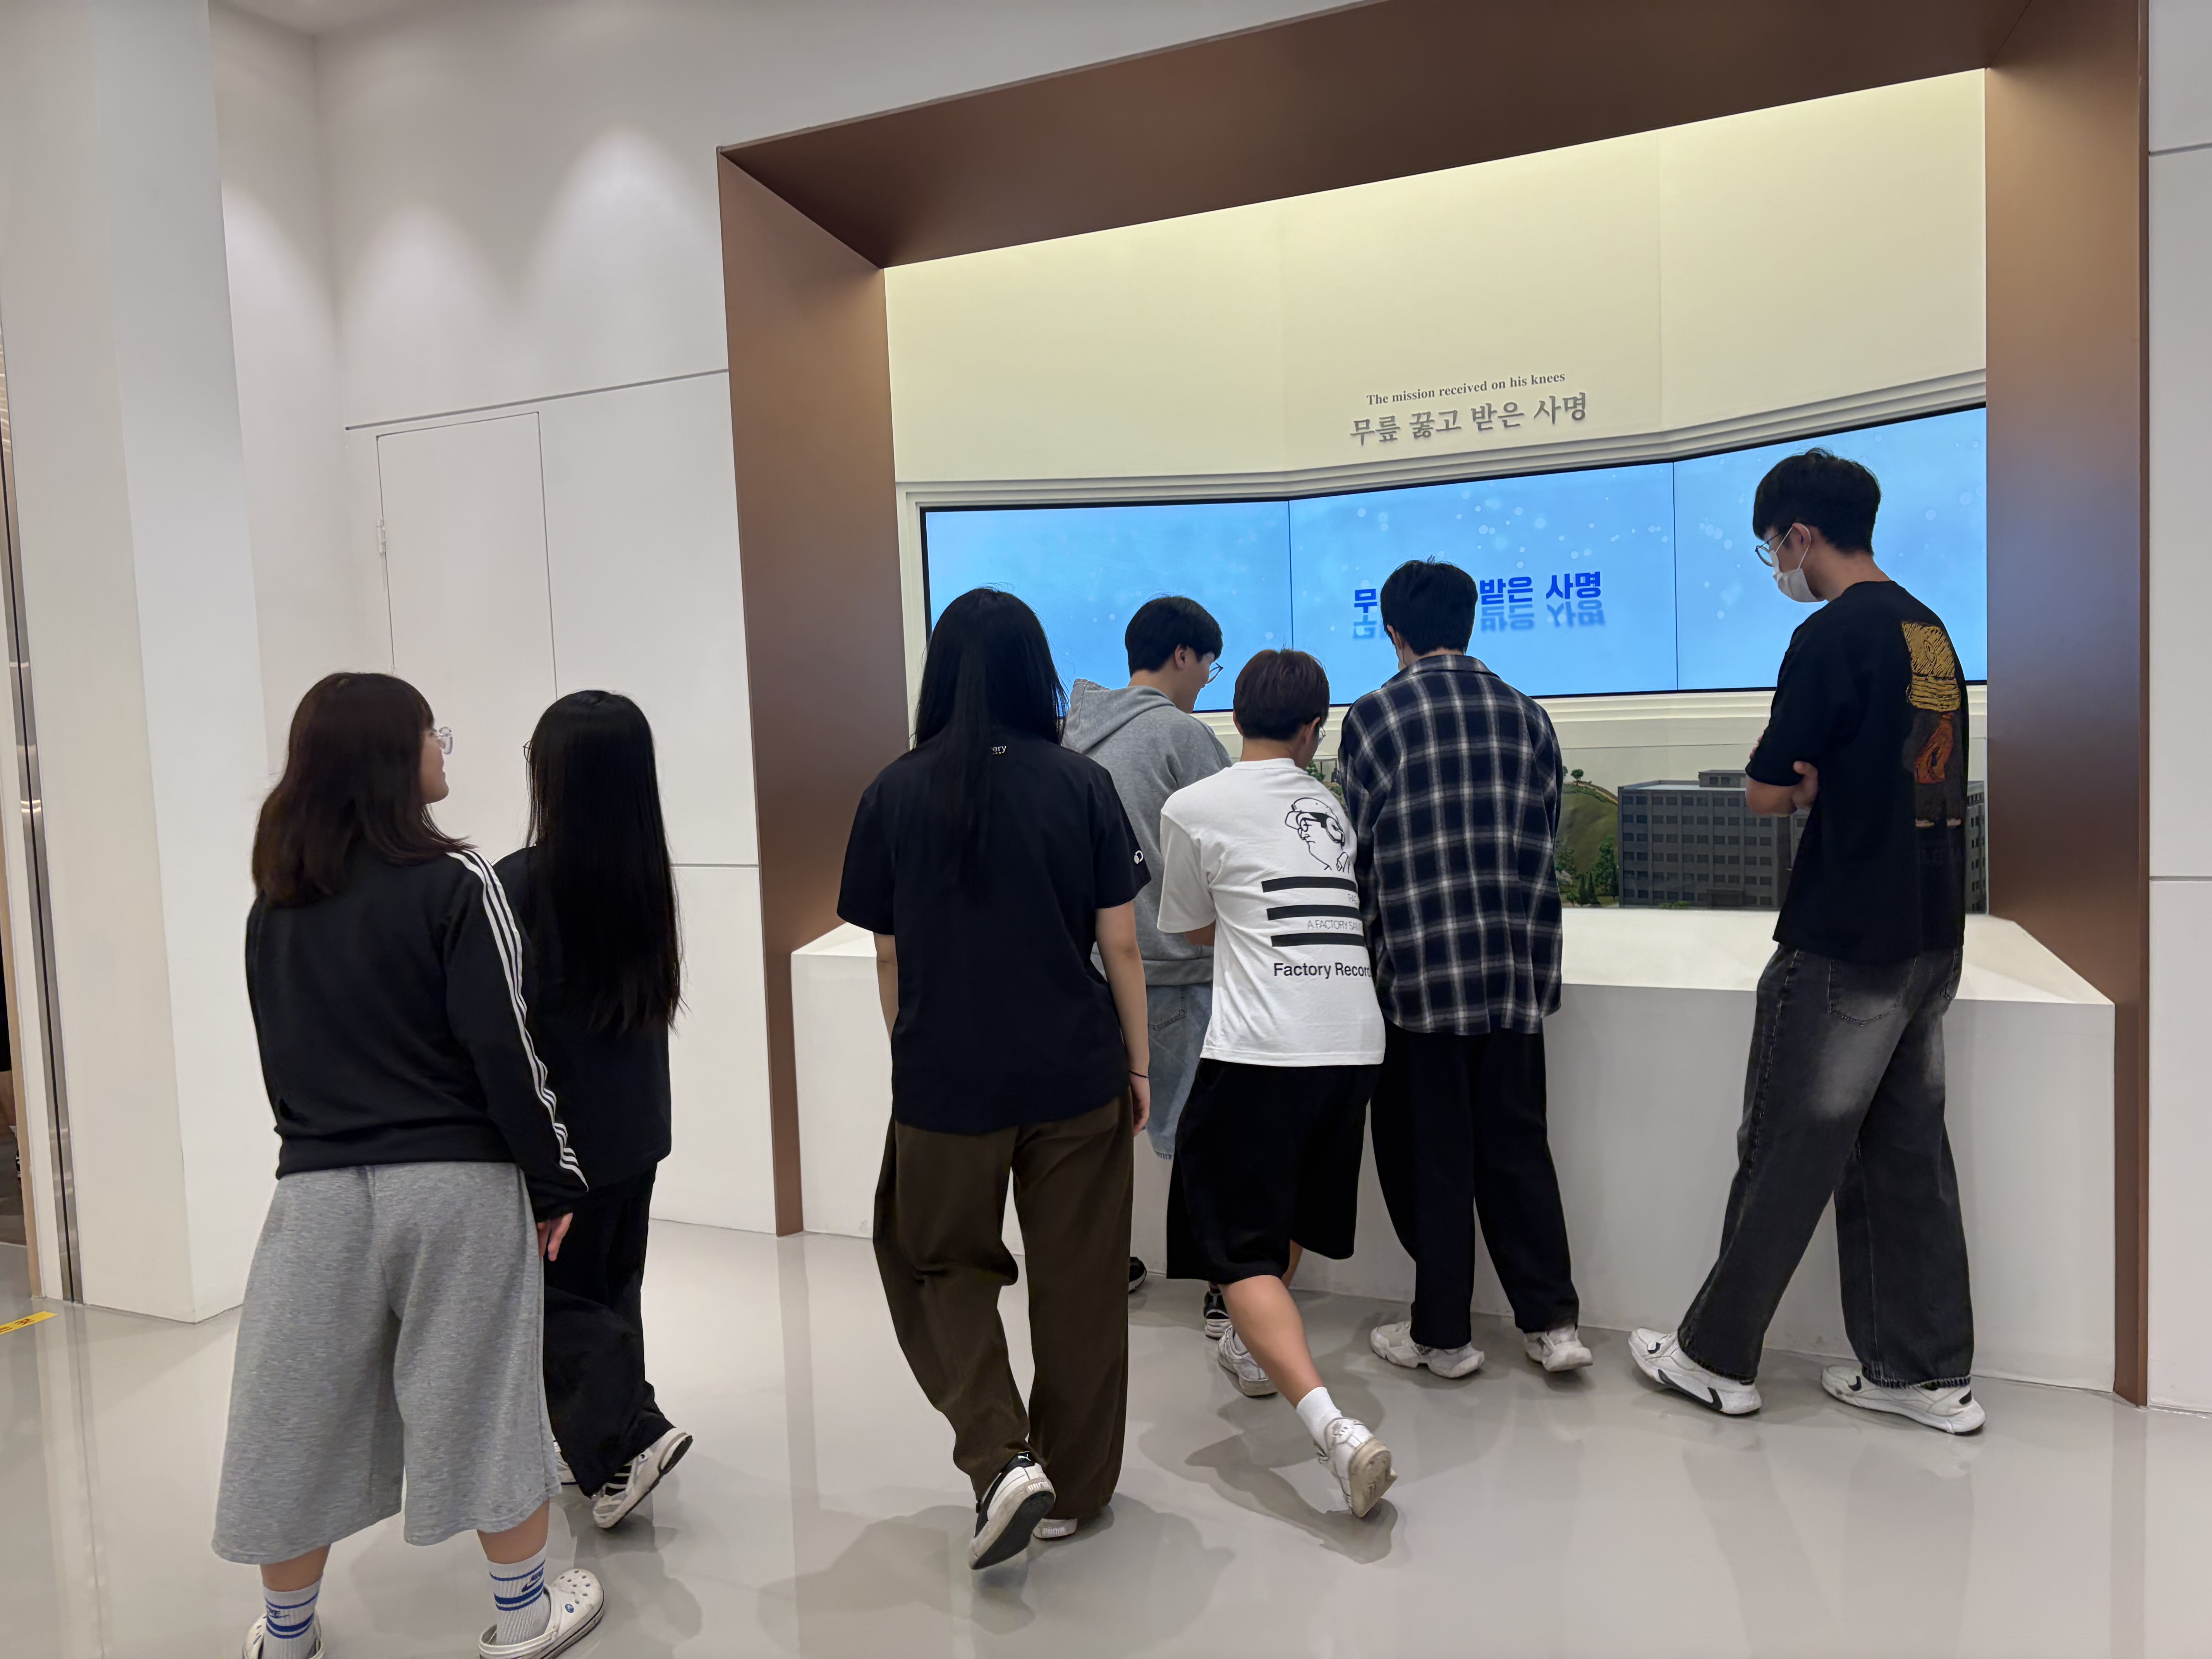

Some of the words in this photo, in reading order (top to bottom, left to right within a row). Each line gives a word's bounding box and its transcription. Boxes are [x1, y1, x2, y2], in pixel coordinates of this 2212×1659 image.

[1366, 394, 1389, 405] The
[1392, 390, 1435, 402] mission
[1439, 381, 1487, 396] received
[1491, 381, 1506, 390] on
[1510, 376, 1527, 388] his
[1531, 374, 1565, 385] knees
[1350, 415, 1401, 446] 무릎
[1409, 410, 1462, 439] 꿇고
[1471, 403, 1524, 431] 받은
[1534, 392, 1585, 424] 사명
[1354, 589, 1377, 613] 무
[1480, 577, 1533, 605] 받은
[1546, 571, 1601, 599] 사명
[1307, 920, 1314, 929] A
[1315, 920, 1348, 929] FACTORY
[1274, 963, 1331, 979] Factory
